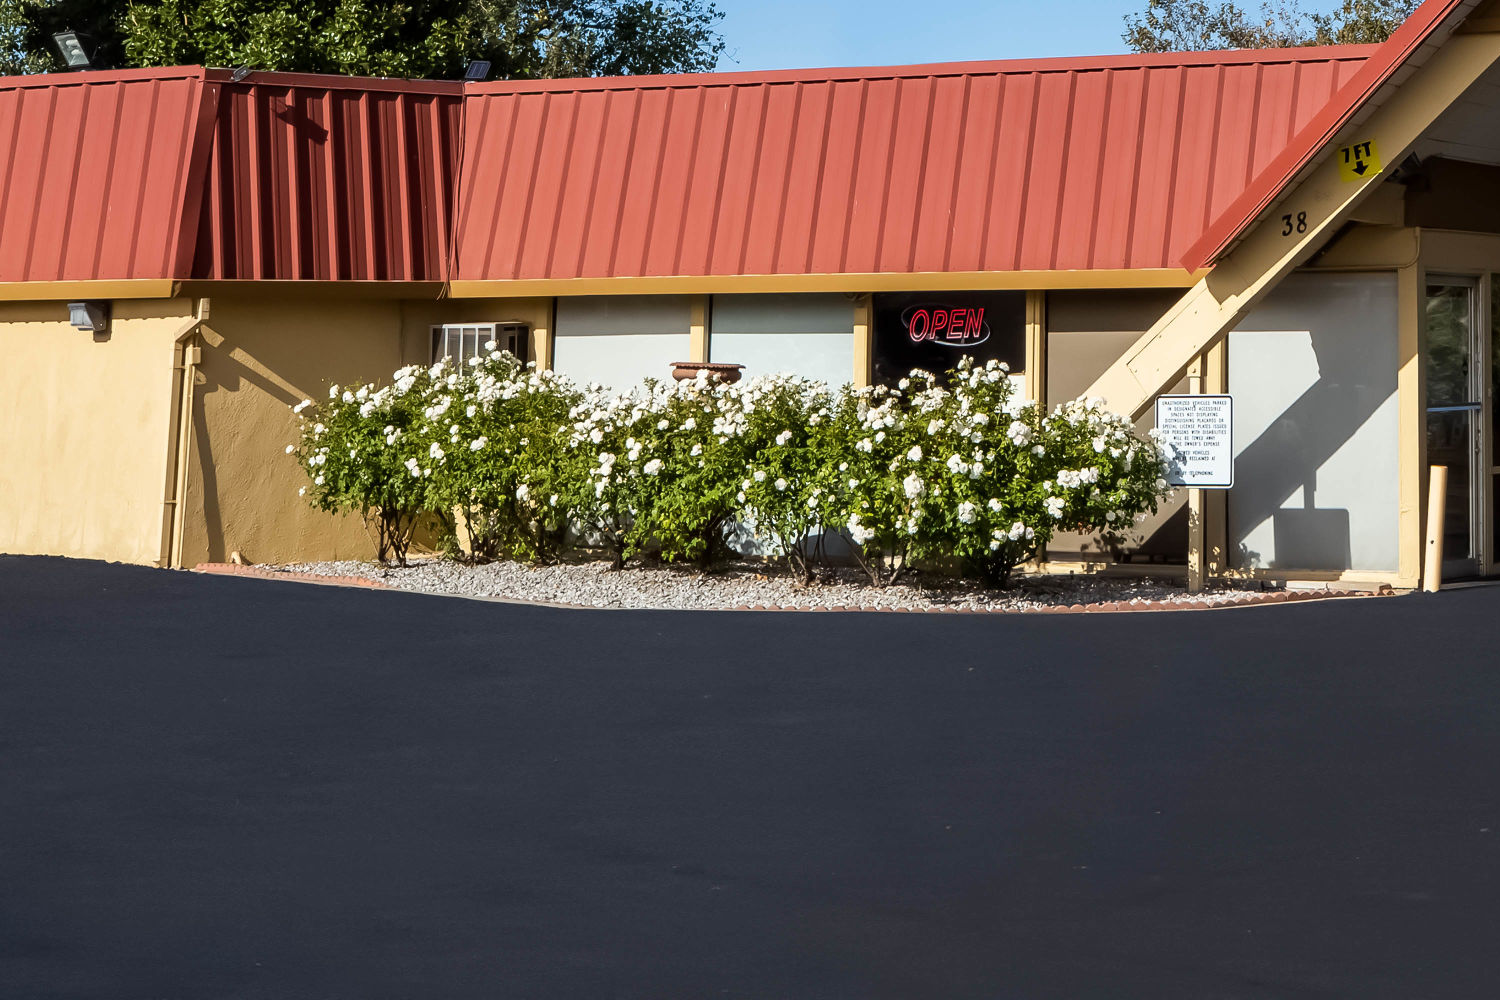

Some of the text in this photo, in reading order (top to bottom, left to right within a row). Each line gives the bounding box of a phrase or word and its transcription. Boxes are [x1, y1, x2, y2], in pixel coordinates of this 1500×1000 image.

[1341, 141, 1371, 164] 7 FT
[1281, 210, 1307, 237] 38
[909, 308, 984, 342] OPEN
